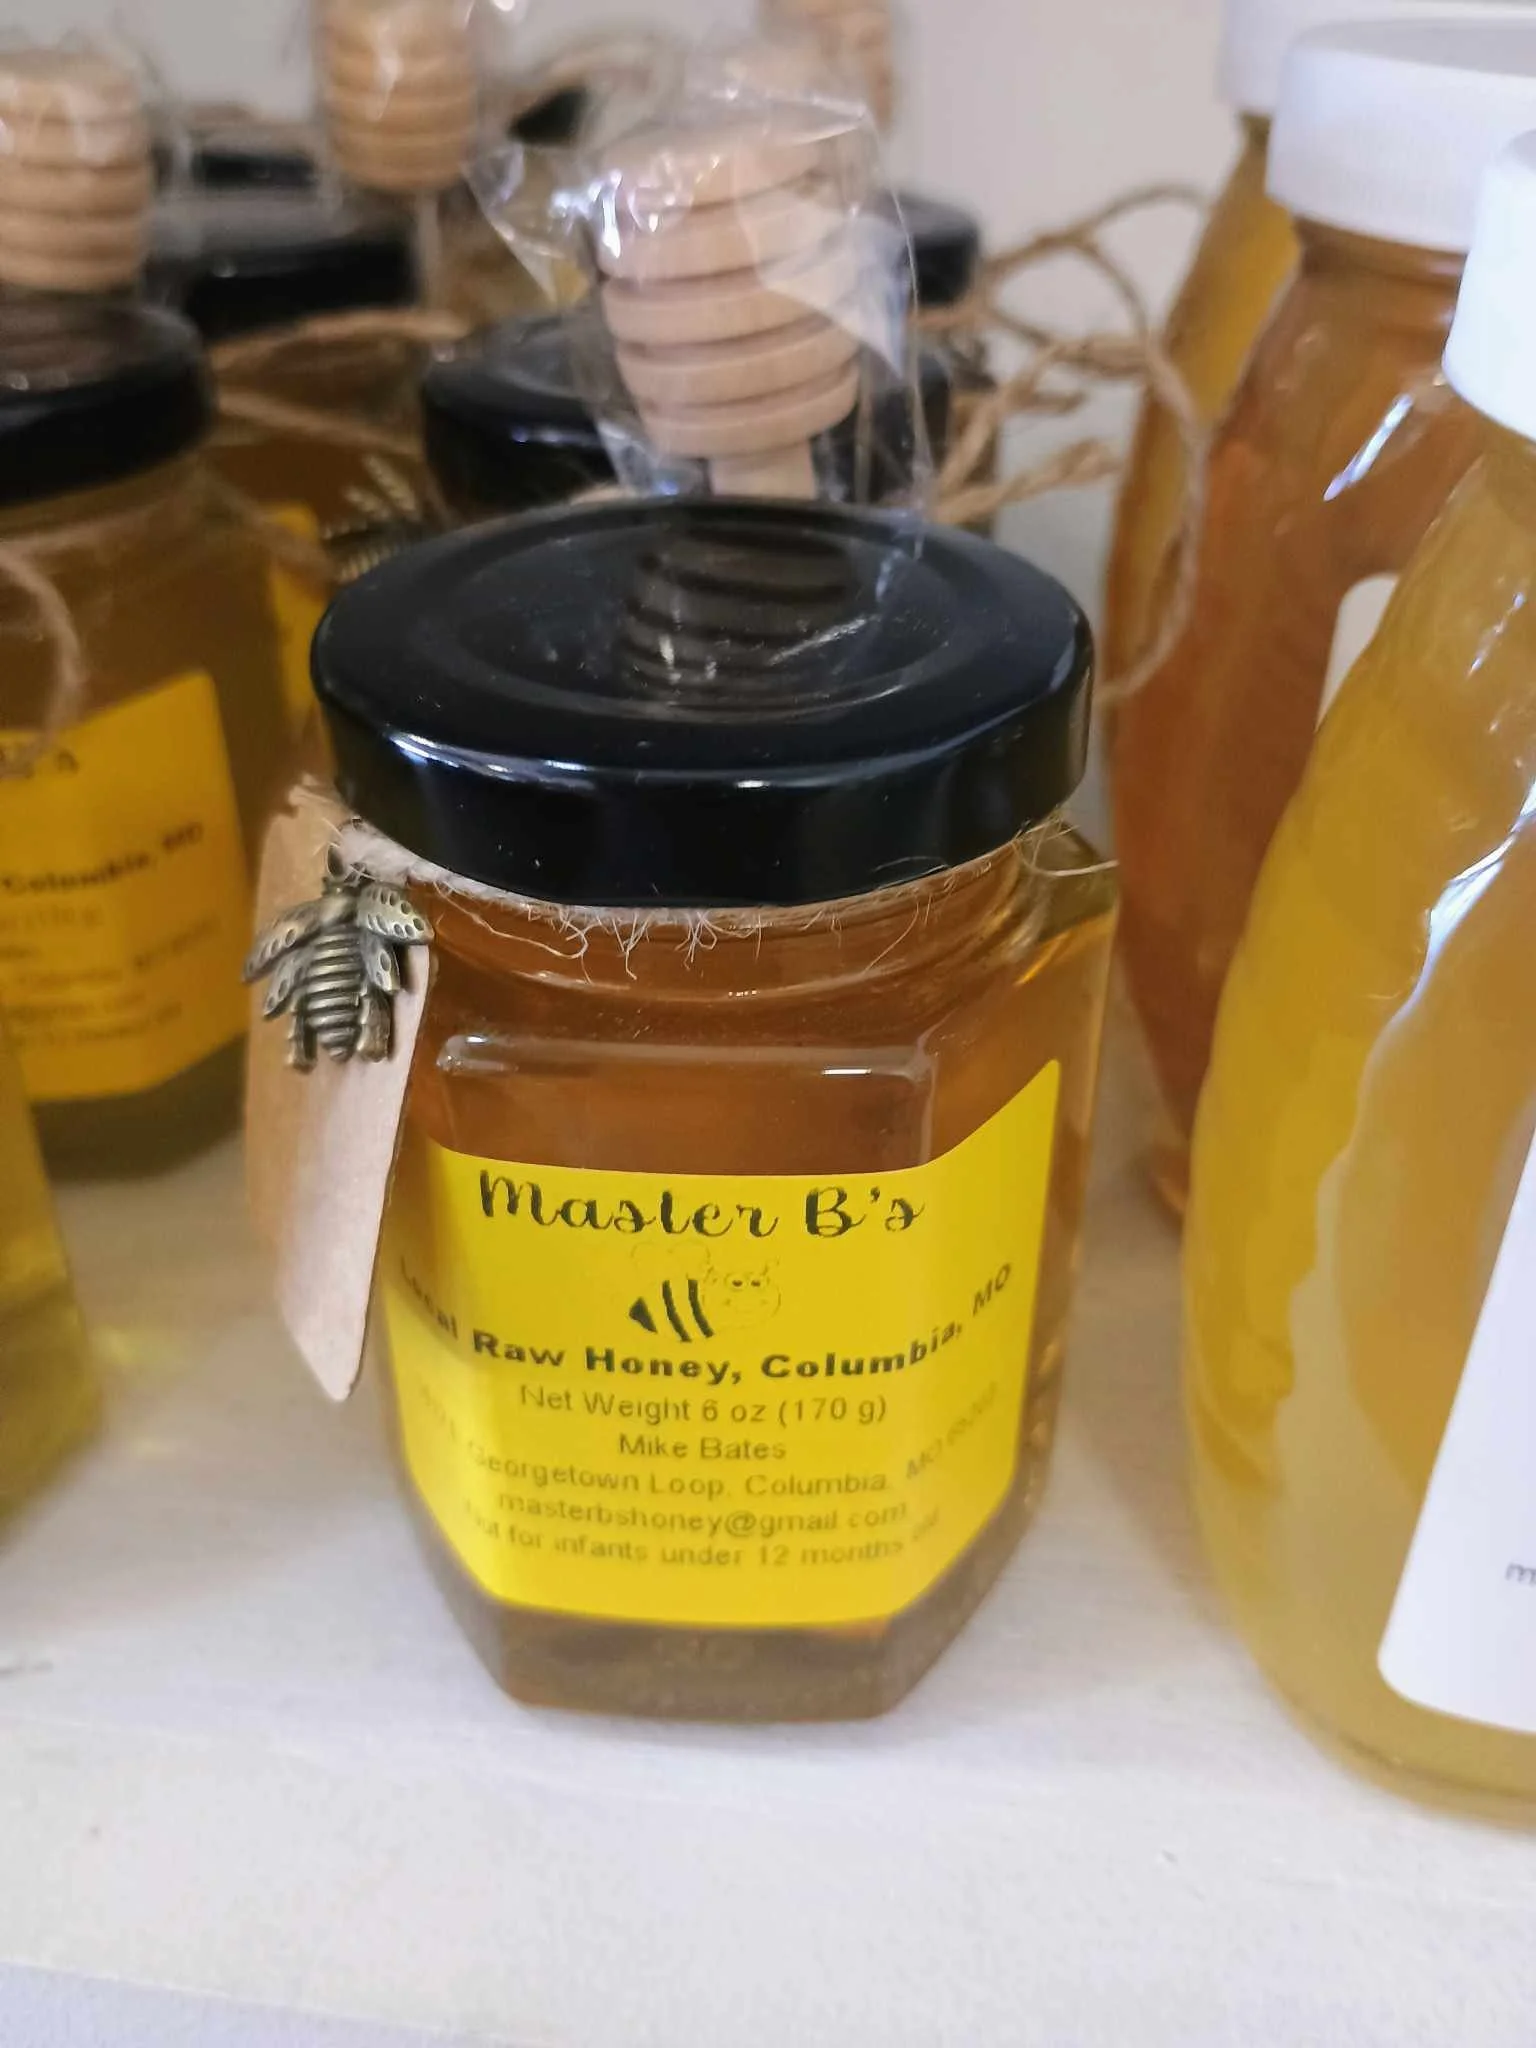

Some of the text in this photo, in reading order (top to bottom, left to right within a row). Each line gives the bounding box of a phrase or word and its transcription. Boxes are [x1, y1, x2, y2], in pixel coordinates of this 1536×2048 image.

[479, 1169, 926, 1239] Master B's
[472, 1328, 567, 1367] Raw
[585, 1345, 742, 1386] Honey,
[760, 1317, 964, 1379] Columbia,
[971, 1261, 1012, 1317] MO
[519, 1383, 887, 1429] Net Weight 6 oz (170 g)
[618, 1432, 788, 1461] Mike Bates
[509, 1523, 545, 1548] for
[553, 1534, 649, 1563] infants
[660, 1544, 745, 1567] under
[759, 1543, 791, 1567] 12
[799, 1539, 905, 1566] months
